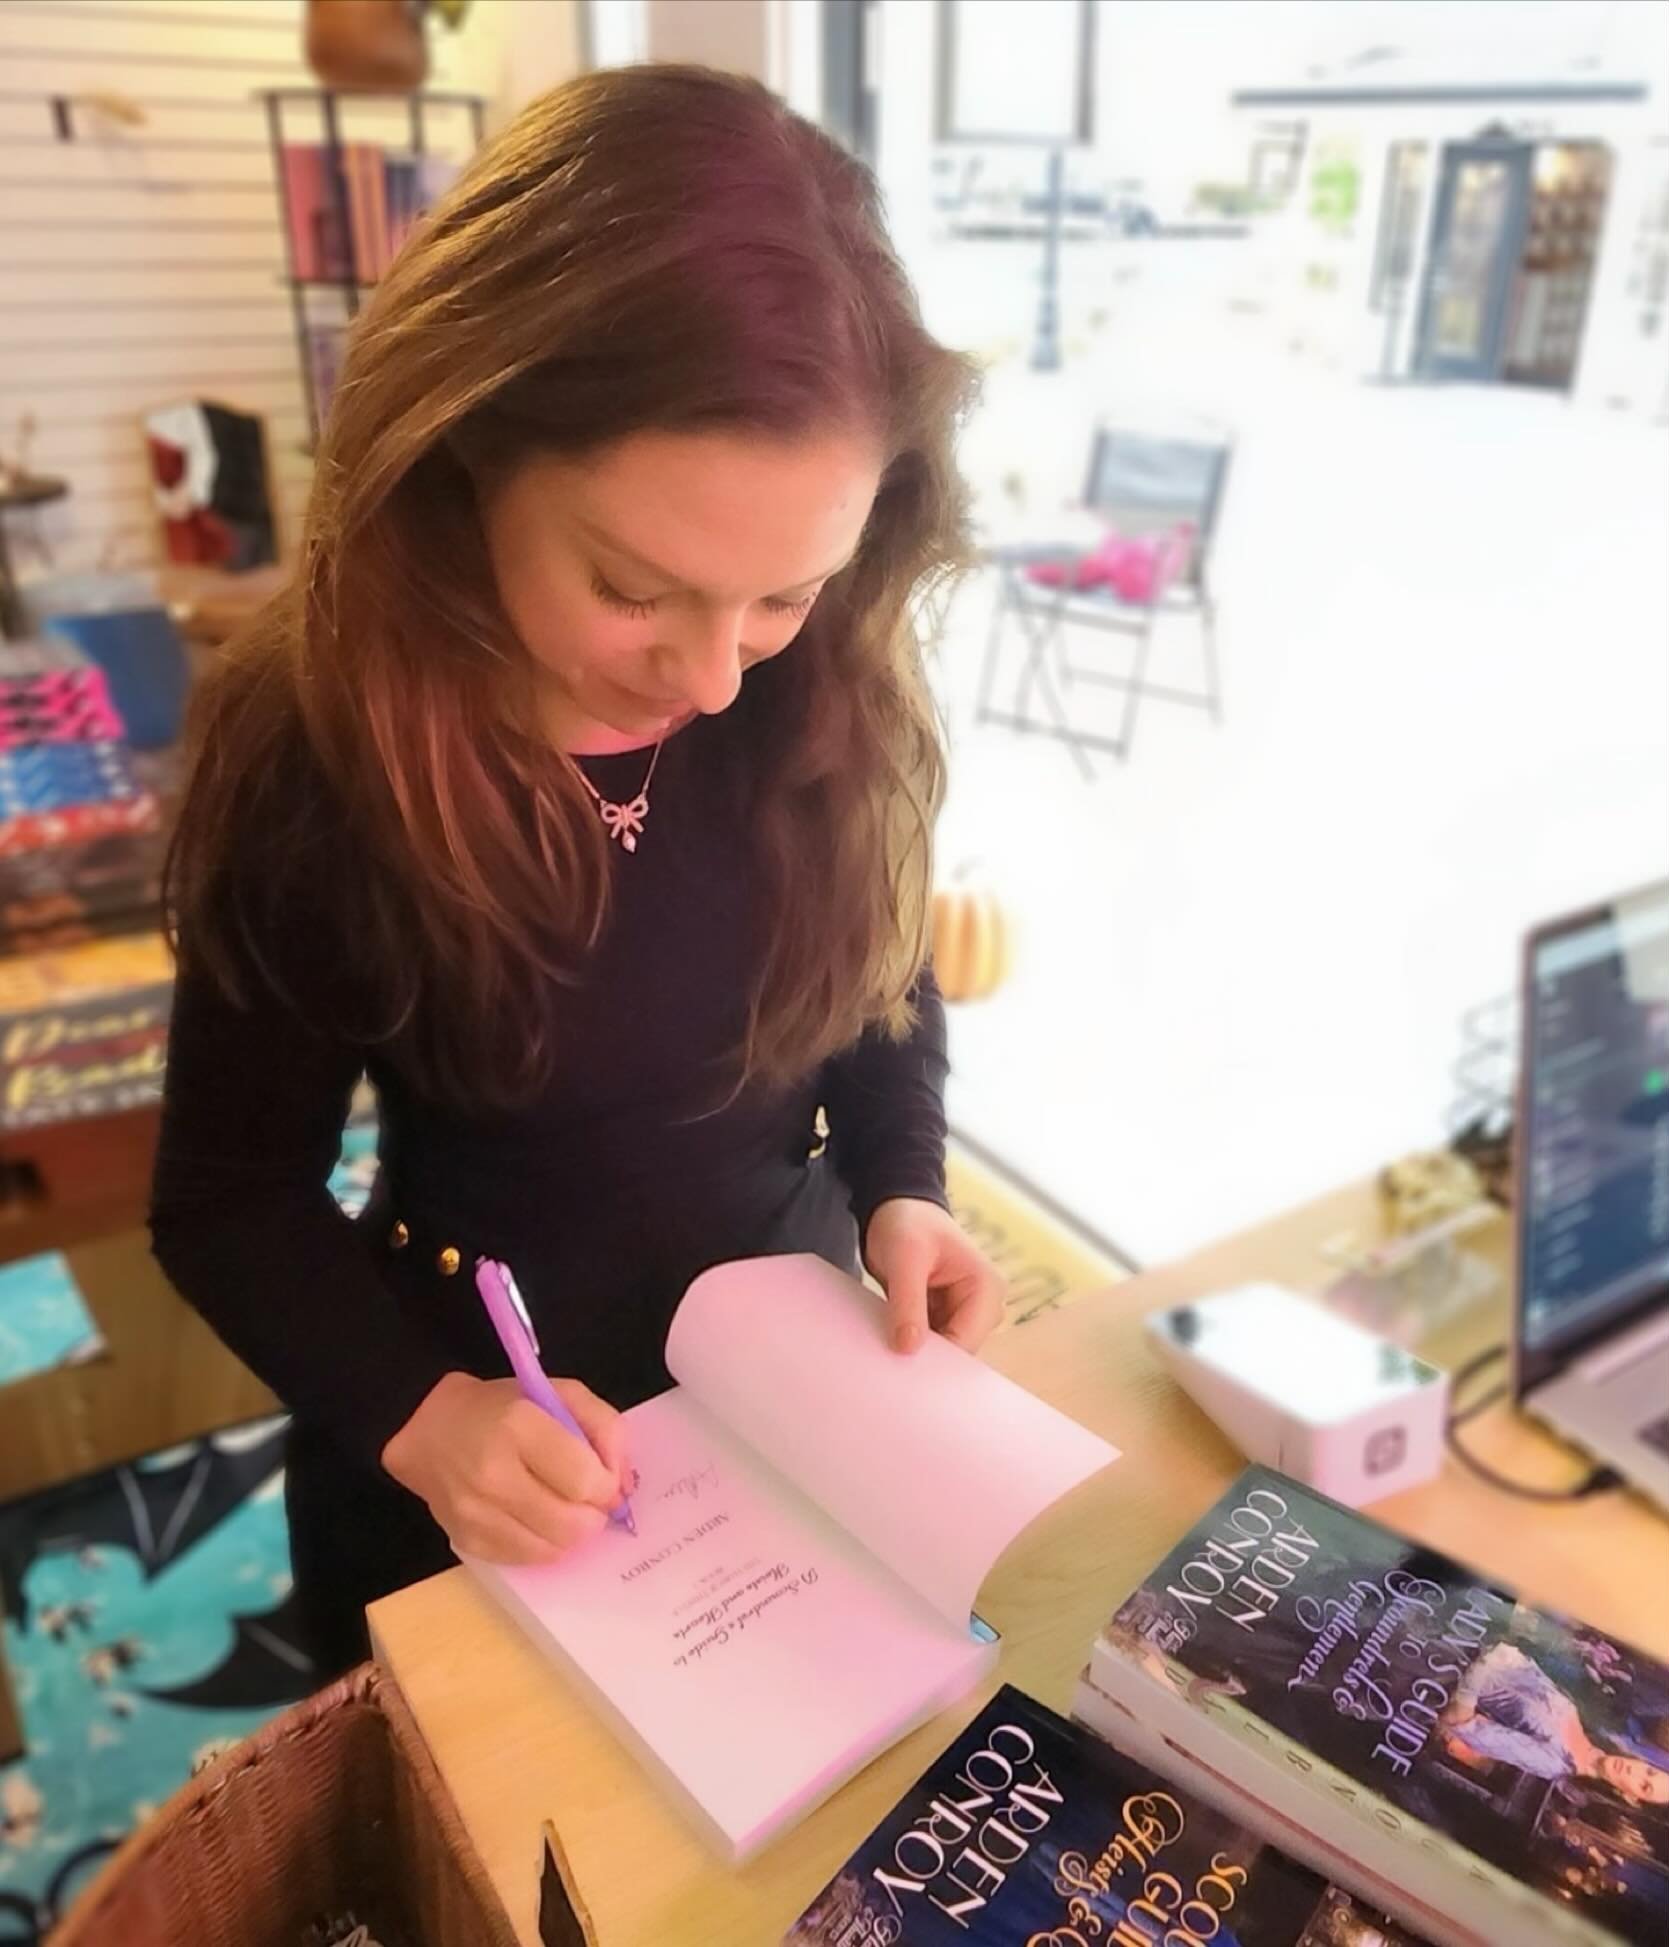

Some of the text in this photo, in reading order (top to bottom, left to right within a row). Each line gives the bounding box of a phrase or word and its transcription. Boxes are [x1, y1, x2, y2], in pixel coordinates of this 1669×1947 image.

[620, 1541, 683, 1583] CONROY
[721, 1588, 746, 1613] and
[1166, 1488, 1288, 1620] CONROY
[1215, 1516, 1320, 1632] ARDEN
[687, 1625, 729, 1659] Guide
[1287, 1580, 1385, 1693] Gentlemen
[1342, 1570, 1446, 1720] Scoundrels
[1371, 1678, 1449, 1776] GUIDE
[872, 1724, 1035, 1918] CONROY
[928, 1761, 1065, 1930] ARDEN
[1054, 1791, 1184, 1898] Heists
[1067, 1896, 1102, 1936] &
